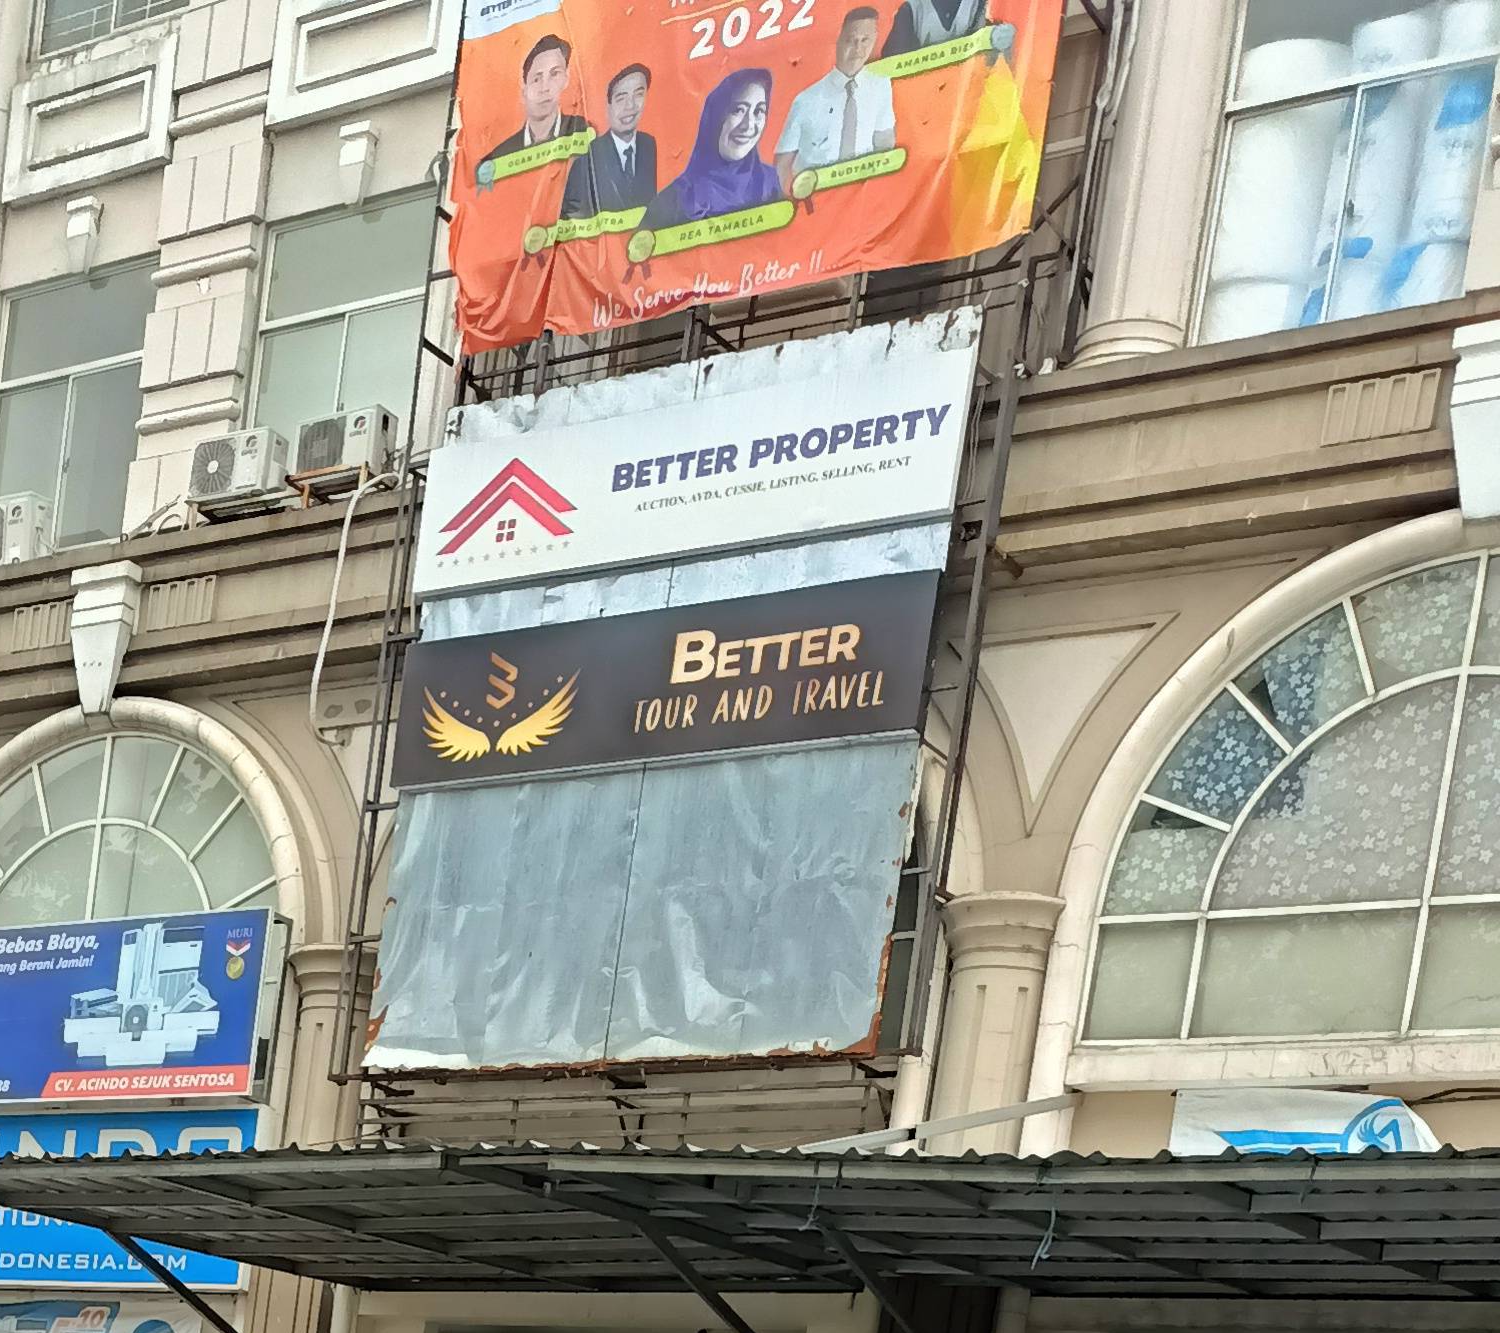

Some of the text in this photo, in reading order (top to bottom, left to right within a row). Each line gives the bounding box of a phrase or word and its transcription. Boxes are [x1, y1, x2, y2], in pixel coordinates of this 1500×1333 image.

[689, 0, 814, 60] 2022
[894, 50, 946, 70] AMANDA
[708, 215, 764, 235] TAMAELA
[593, 292, 624, 328] We
[631, 286, 684, 320] Serve
[691, 272, 733, 303] You
[739, 260, 801, 295] Better
[611, 402, 952, 492] BETTER PROPERTY
[634, 495, 688, 513] AUCTION,
[769, 472, 819, 490] LISTING,
[821, 462, 876, 481] SELLING,
[878, 455, 912, 471] RENT
[633, 693, 698, 734] TOUR
[711, 684, 774, 724] AND
[47, 932, 100, 954] Biaya,
[19, 957, 55, 972] Berani
[54, 1072, 236, 1092] CV. ACINDO SEJUK SENTOSA
